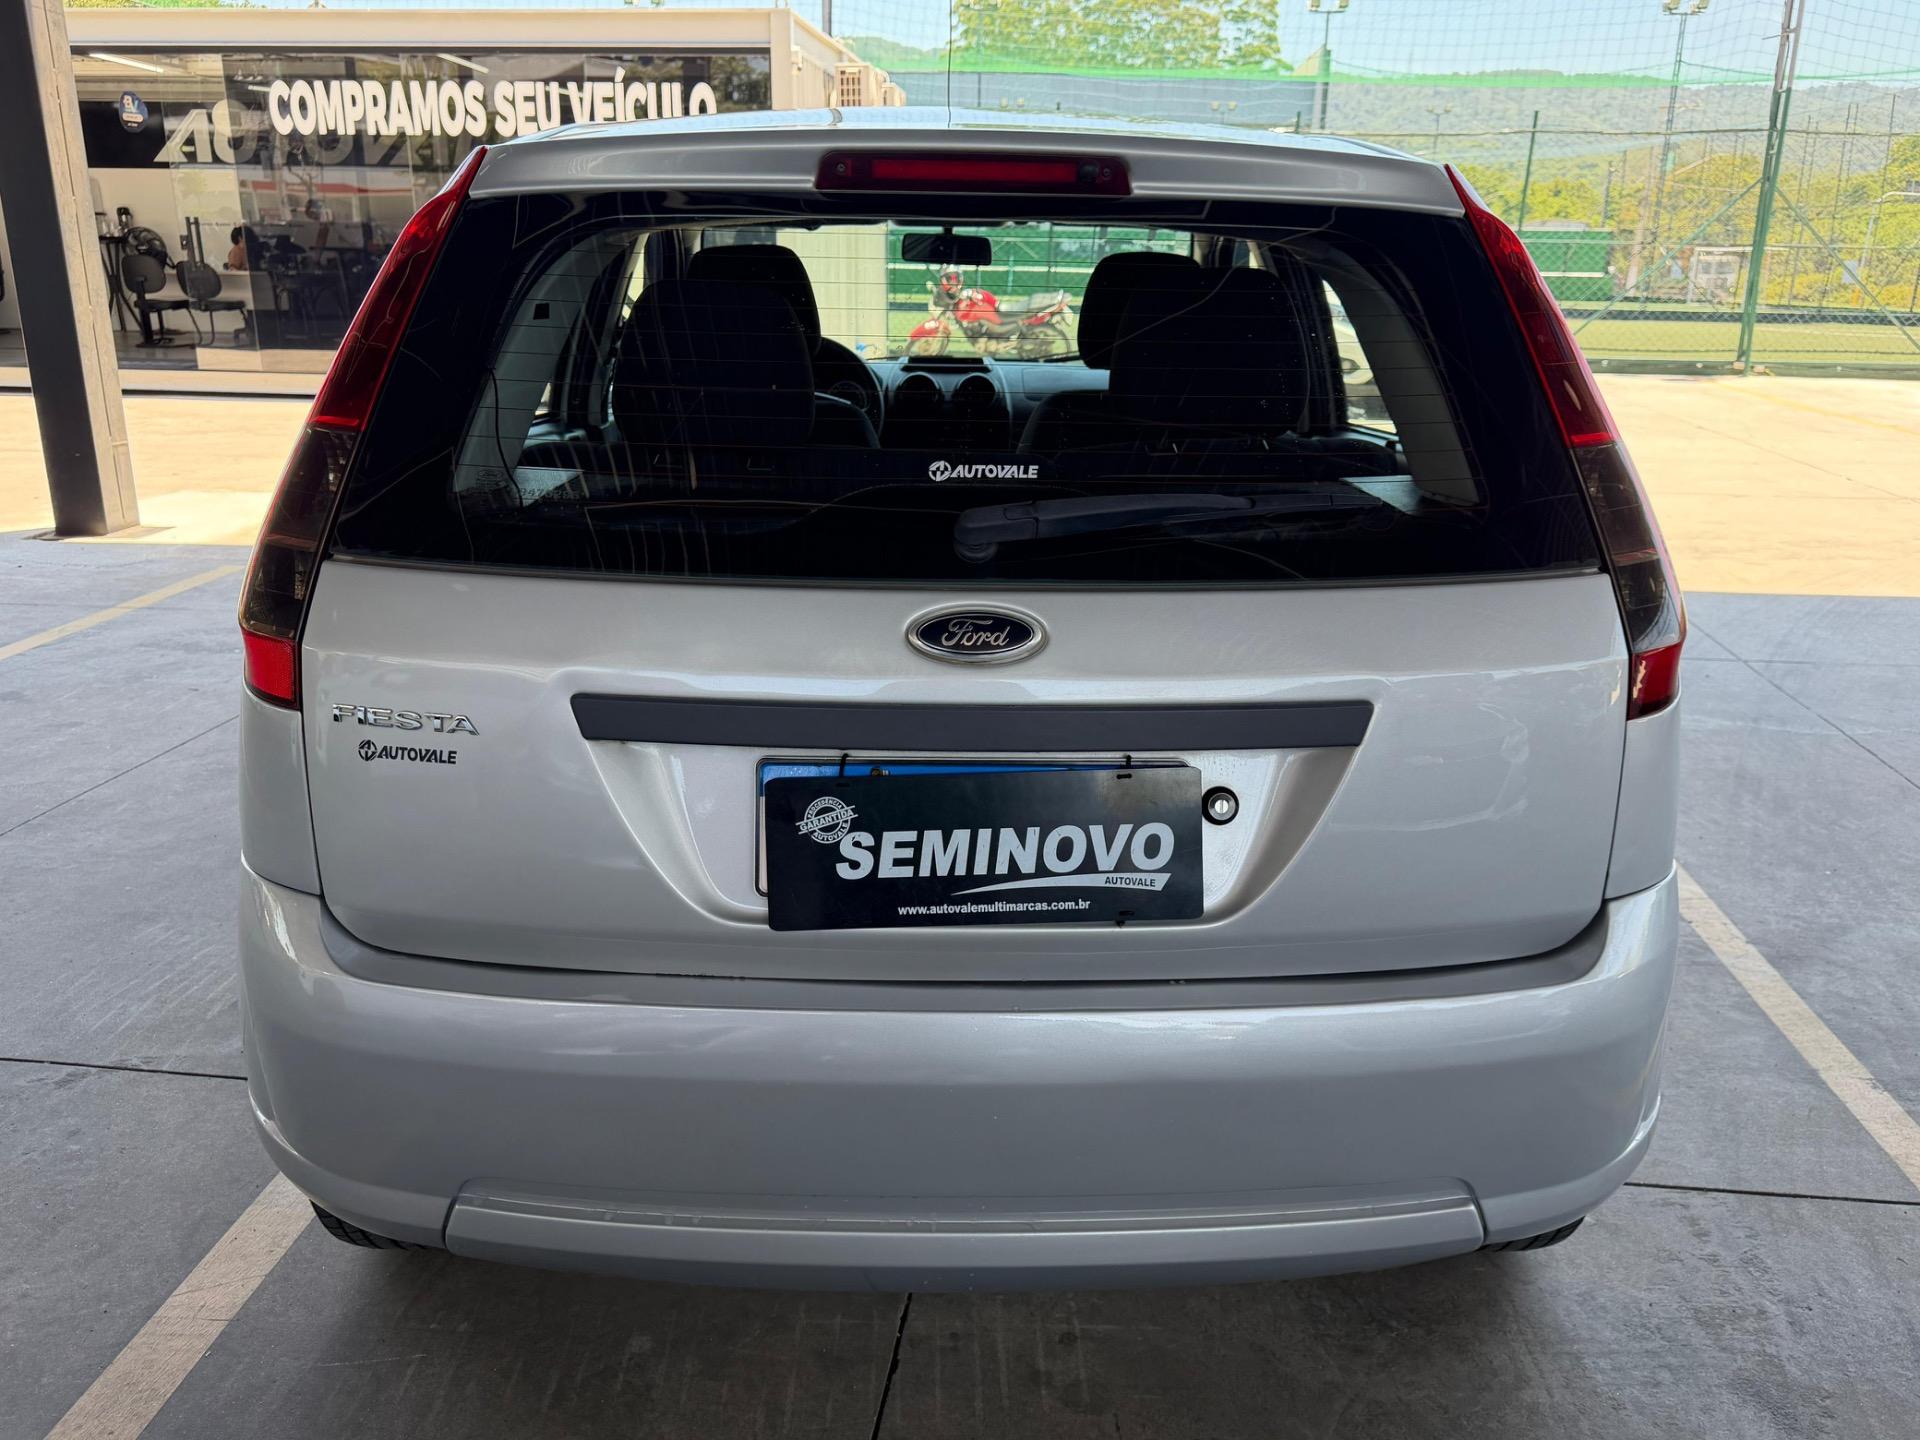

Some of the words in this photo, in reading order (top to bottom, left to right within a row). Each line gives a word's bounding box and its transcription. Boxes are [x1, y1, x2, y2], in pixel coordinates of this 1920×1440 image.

[269, 79, 488, 137] COMPRAMOS
[494, 79, 562, 137] SEU
[950, 464, 1039, 479] AUTOVALE
[941, 618, 1010, 646] Ford
[332, 703, 480, 736] FIESTA
[378, 745, 458, 765] AUTOVALE
[799, 807, 855, 831] GARANTIDA
[836, 822, 1175, 880] SEMINOVO
[1104, 875, 1156, 888] AUTOVALE
[898, 898, 1091, 915] www.autovalemultimarcas.com.br
